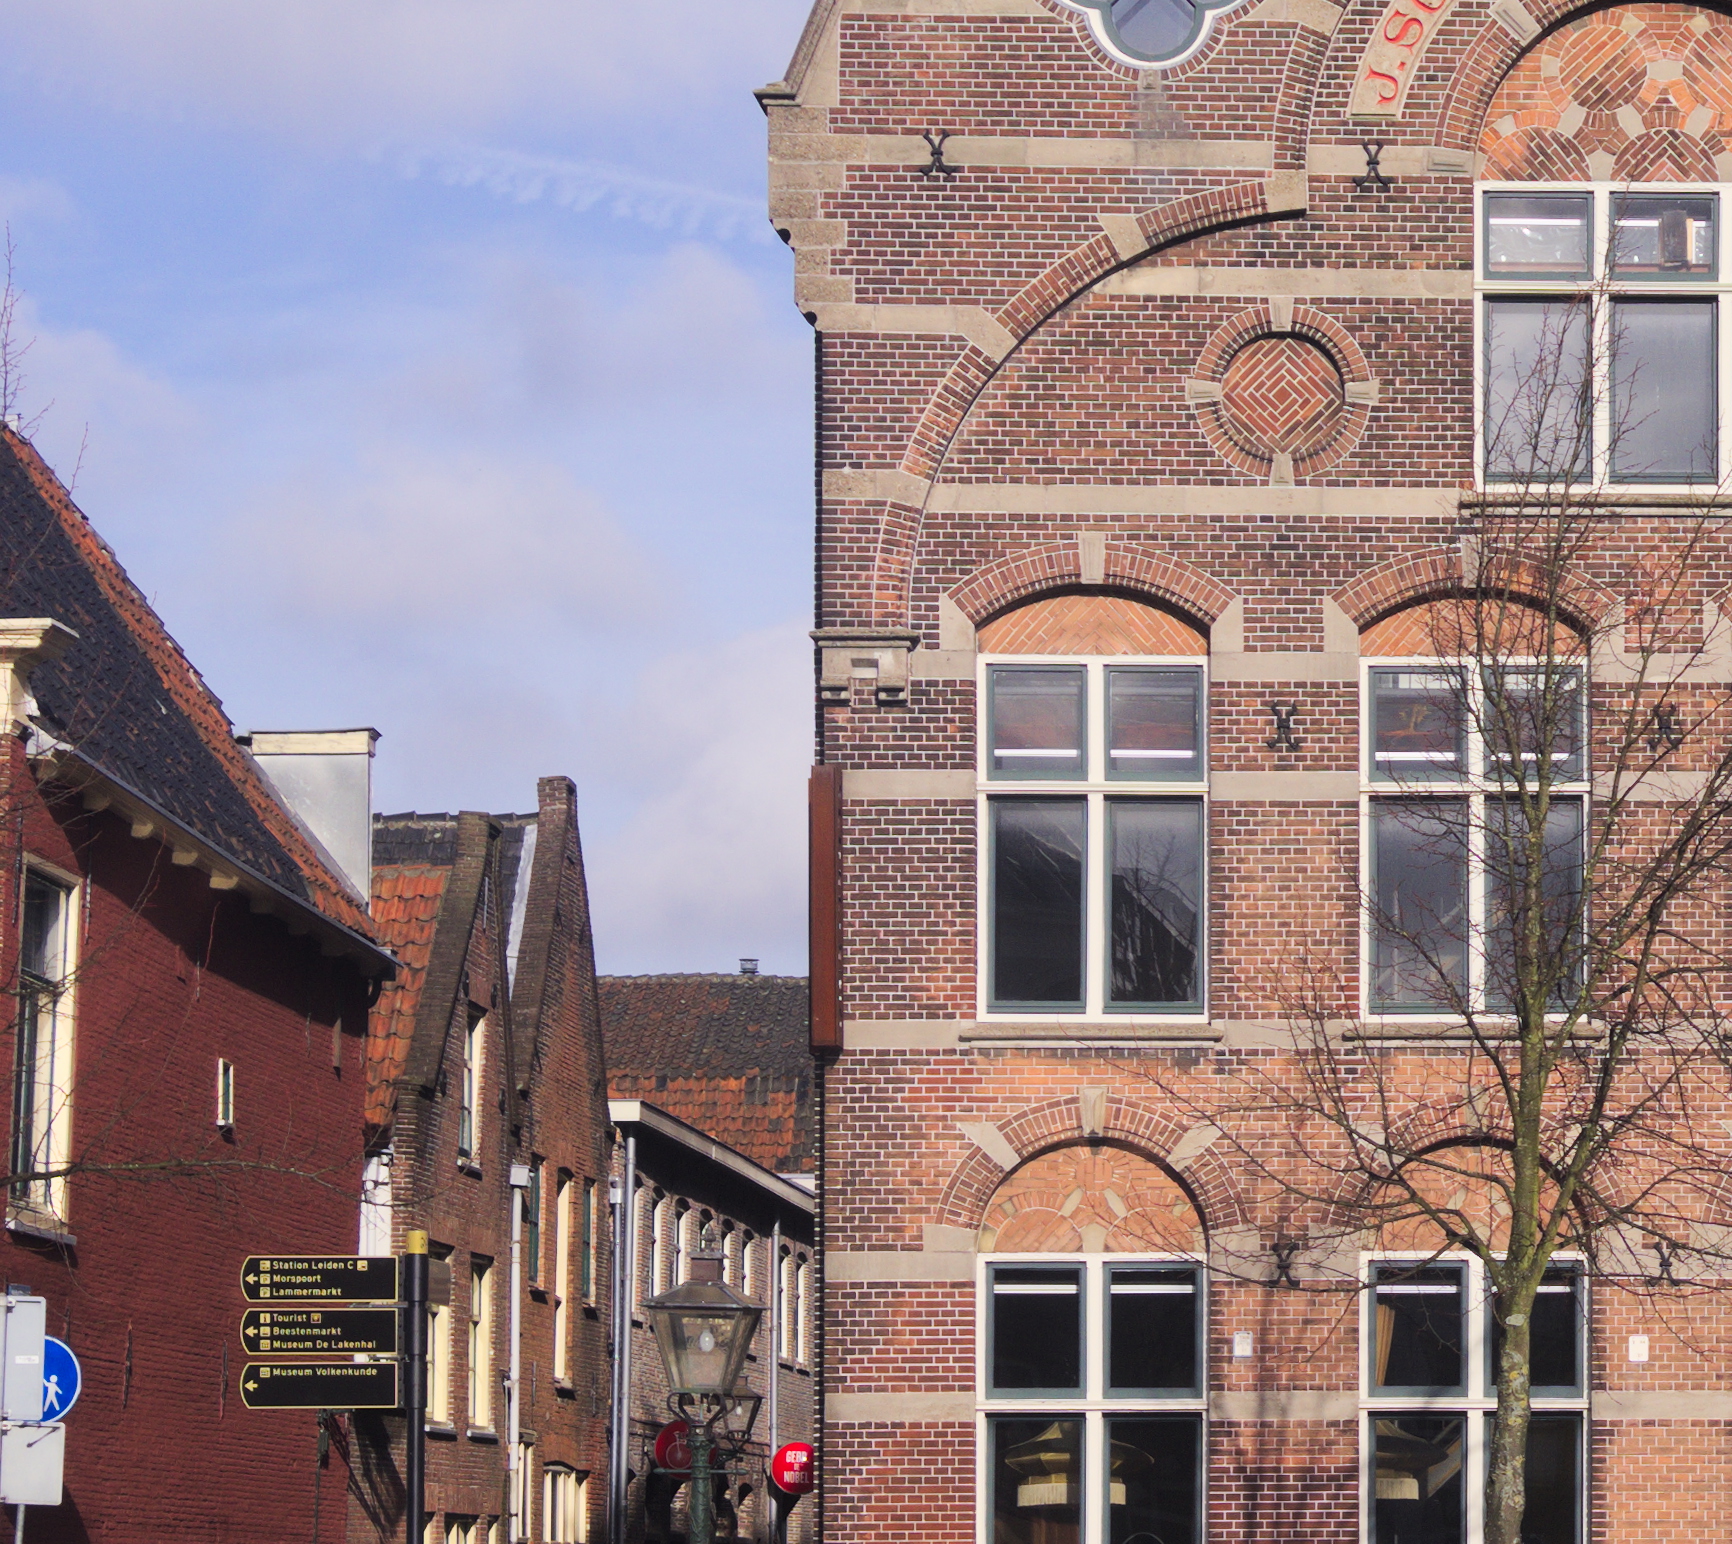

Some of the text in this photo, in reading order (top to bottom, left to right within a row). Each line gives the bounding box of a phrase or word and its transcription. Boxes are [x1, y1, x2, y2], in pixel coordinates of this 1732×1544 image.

[273, 1260, 354, 1270] Station Leiden C
[273, 1274, 322, 1284] Morspoort
[273, 1287, 342, 1296] Lammermarkt
[273, 1313, 307, 1323] Tourist
[273, 1327, 342, 1336] Beestenmarkt
[273, 1340, 377, 1349] Museum De Lakenhal
[273, 1367, 378, 1376] Museum Volkenkunde
[784, 1471, 809, 1483] NOBEL
